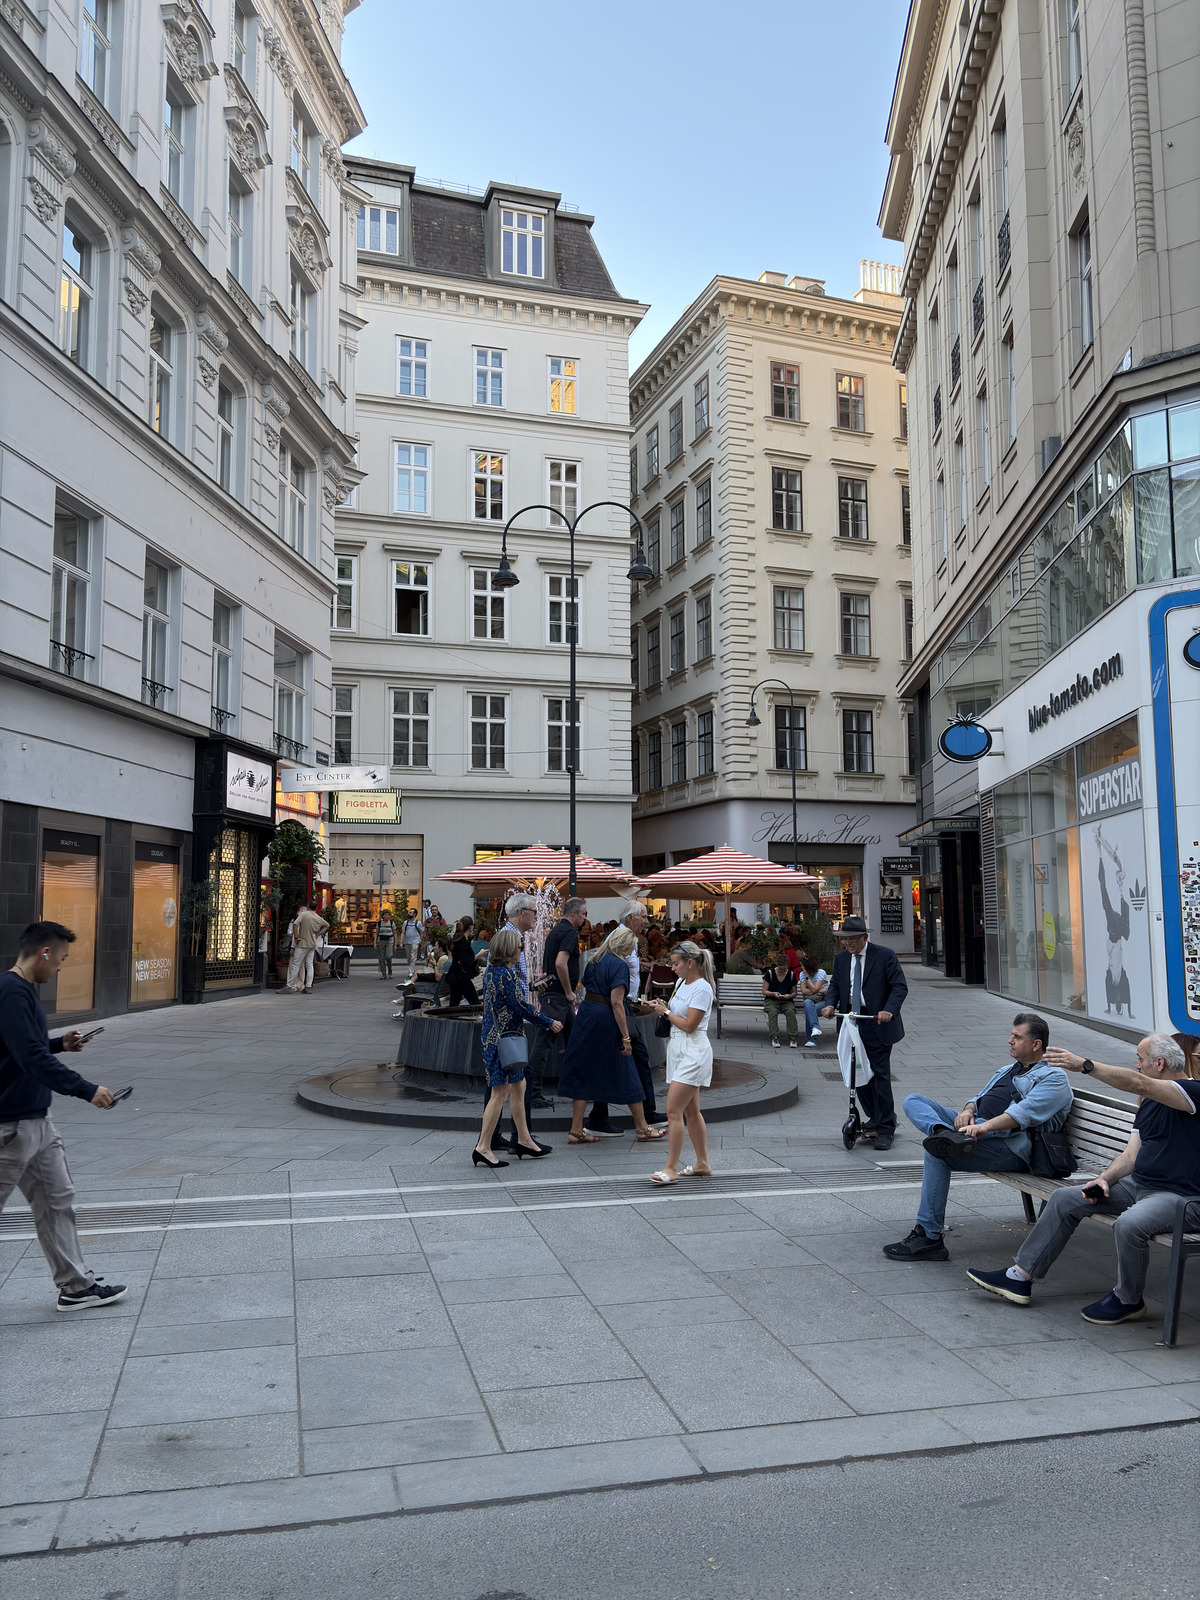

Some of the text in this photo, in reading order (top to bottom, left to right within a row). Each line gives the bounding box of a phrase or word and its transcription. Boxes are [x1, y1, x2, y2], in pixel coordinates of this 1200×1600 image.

[1028, 652, 1123, 733] blue-tomato.com
[1079, 761, 1142, 817] SUPERSTAR
[345, 800, 389, 809] FIGOLETTA
[752, 811, 882, 846] Haas & Haas
[135, 958, 172, 971] NEW SEASON
[135, 968, 171, 982] NEW BEAUTY
